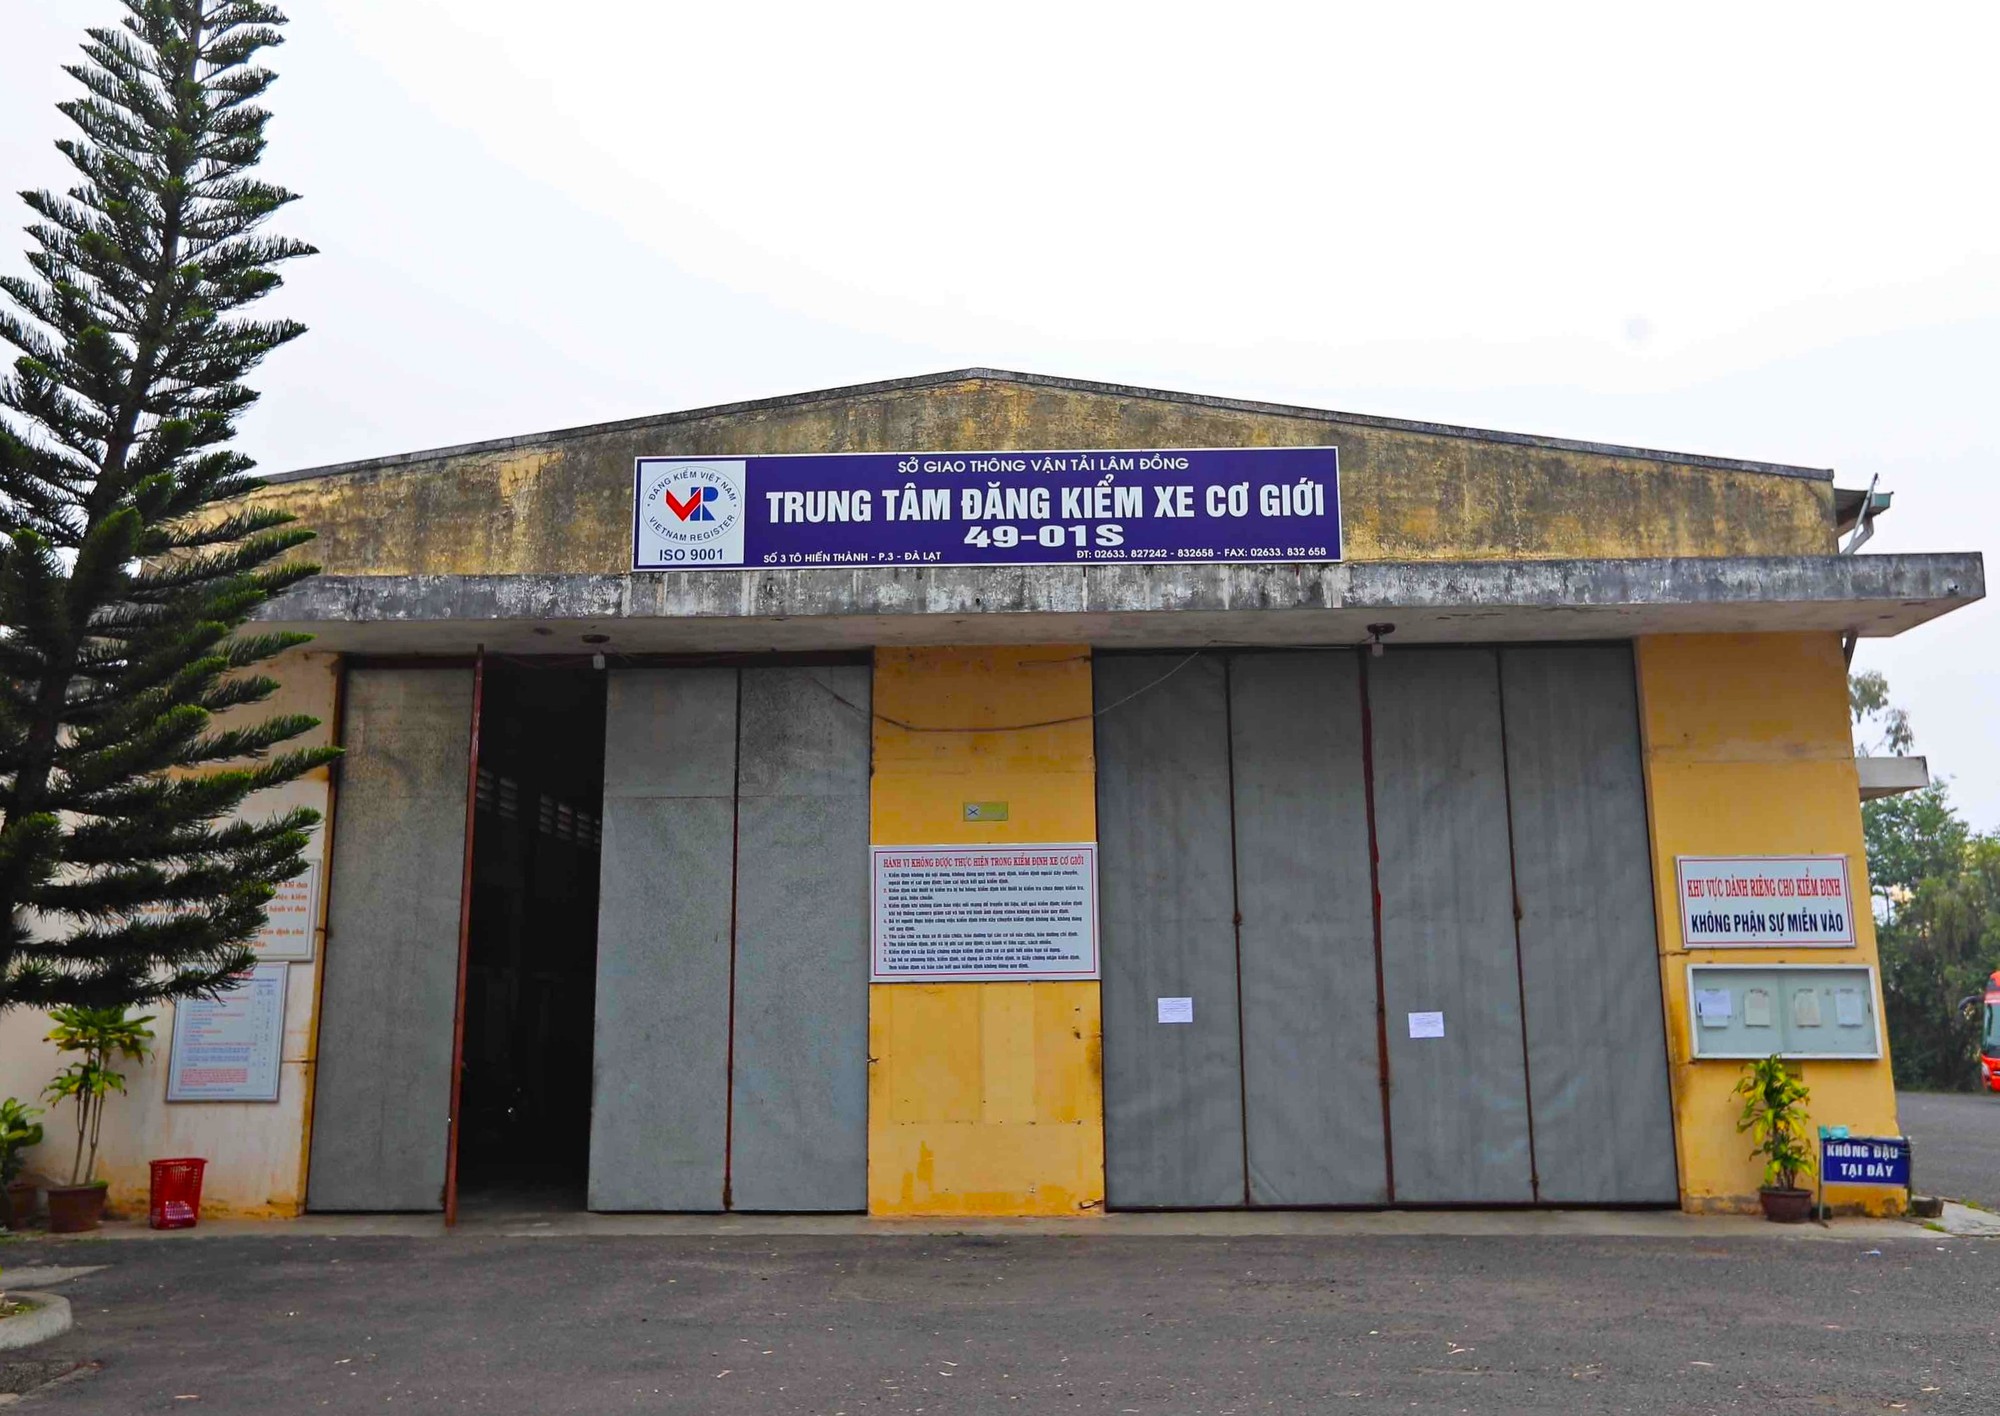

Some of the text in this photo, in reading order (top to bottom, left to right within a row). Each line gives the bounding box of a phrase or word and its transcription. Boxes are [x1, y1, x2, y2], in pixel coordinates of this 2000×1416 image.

[898, 453, 1189, 474] SỞ GIAO THÔNG VẬN TẢI LÂM ĐỒNG
[648, 468, 736, 501] ĐĂNG KIỂM VIỆT NAM
[766, 473, 1324, 523] TRUNG TÂM ĐĂNG KIỂM XE CƠ GIỚI
[649, 514, 735, 542] VIETNAM REGISTER
[660, 548, 723, 561] ISO 9001
[763, 550, 941, 563] SỐ 3 TÔ HIẾN THÀNH P.3 ĐÀ LẠT
[1076, 547, 1326, 559] ĐT: 02633. 827242 832658 FAX: 02633. 832 658
[883, 857, 902, 868] HÀNH
[903, 859, 910, 868] VI
[911, 856, 934, 868] KHÔNG
[935, 857, 952, 868] ĐƯỢC
[954, 856, 973, 868] THỰC
[973, 855, 989, 869] HIỆN
[991, 857, 1012, 867] TRONG
[1013, 852, 1030, 866] KIỂM
[1031, 857, 1048, 868] ĐỊNH
[1049, 856, 1059, 866] XE
[1059, 855, 1069, 866] CƠ
[1687, 867, 1841, 901] KHU VỰC DÀNH RIÊNG CHO KIỂM ĐỊNH
[1691, 907, 1843, 937] KHÔNG PHẬN SỰ MIỄN VÀO
[1826, 1143, 1898, 1161] KHÔNG ĐẬU
[1840, 1163, 1894, 1178] TẠI ĐÂY
